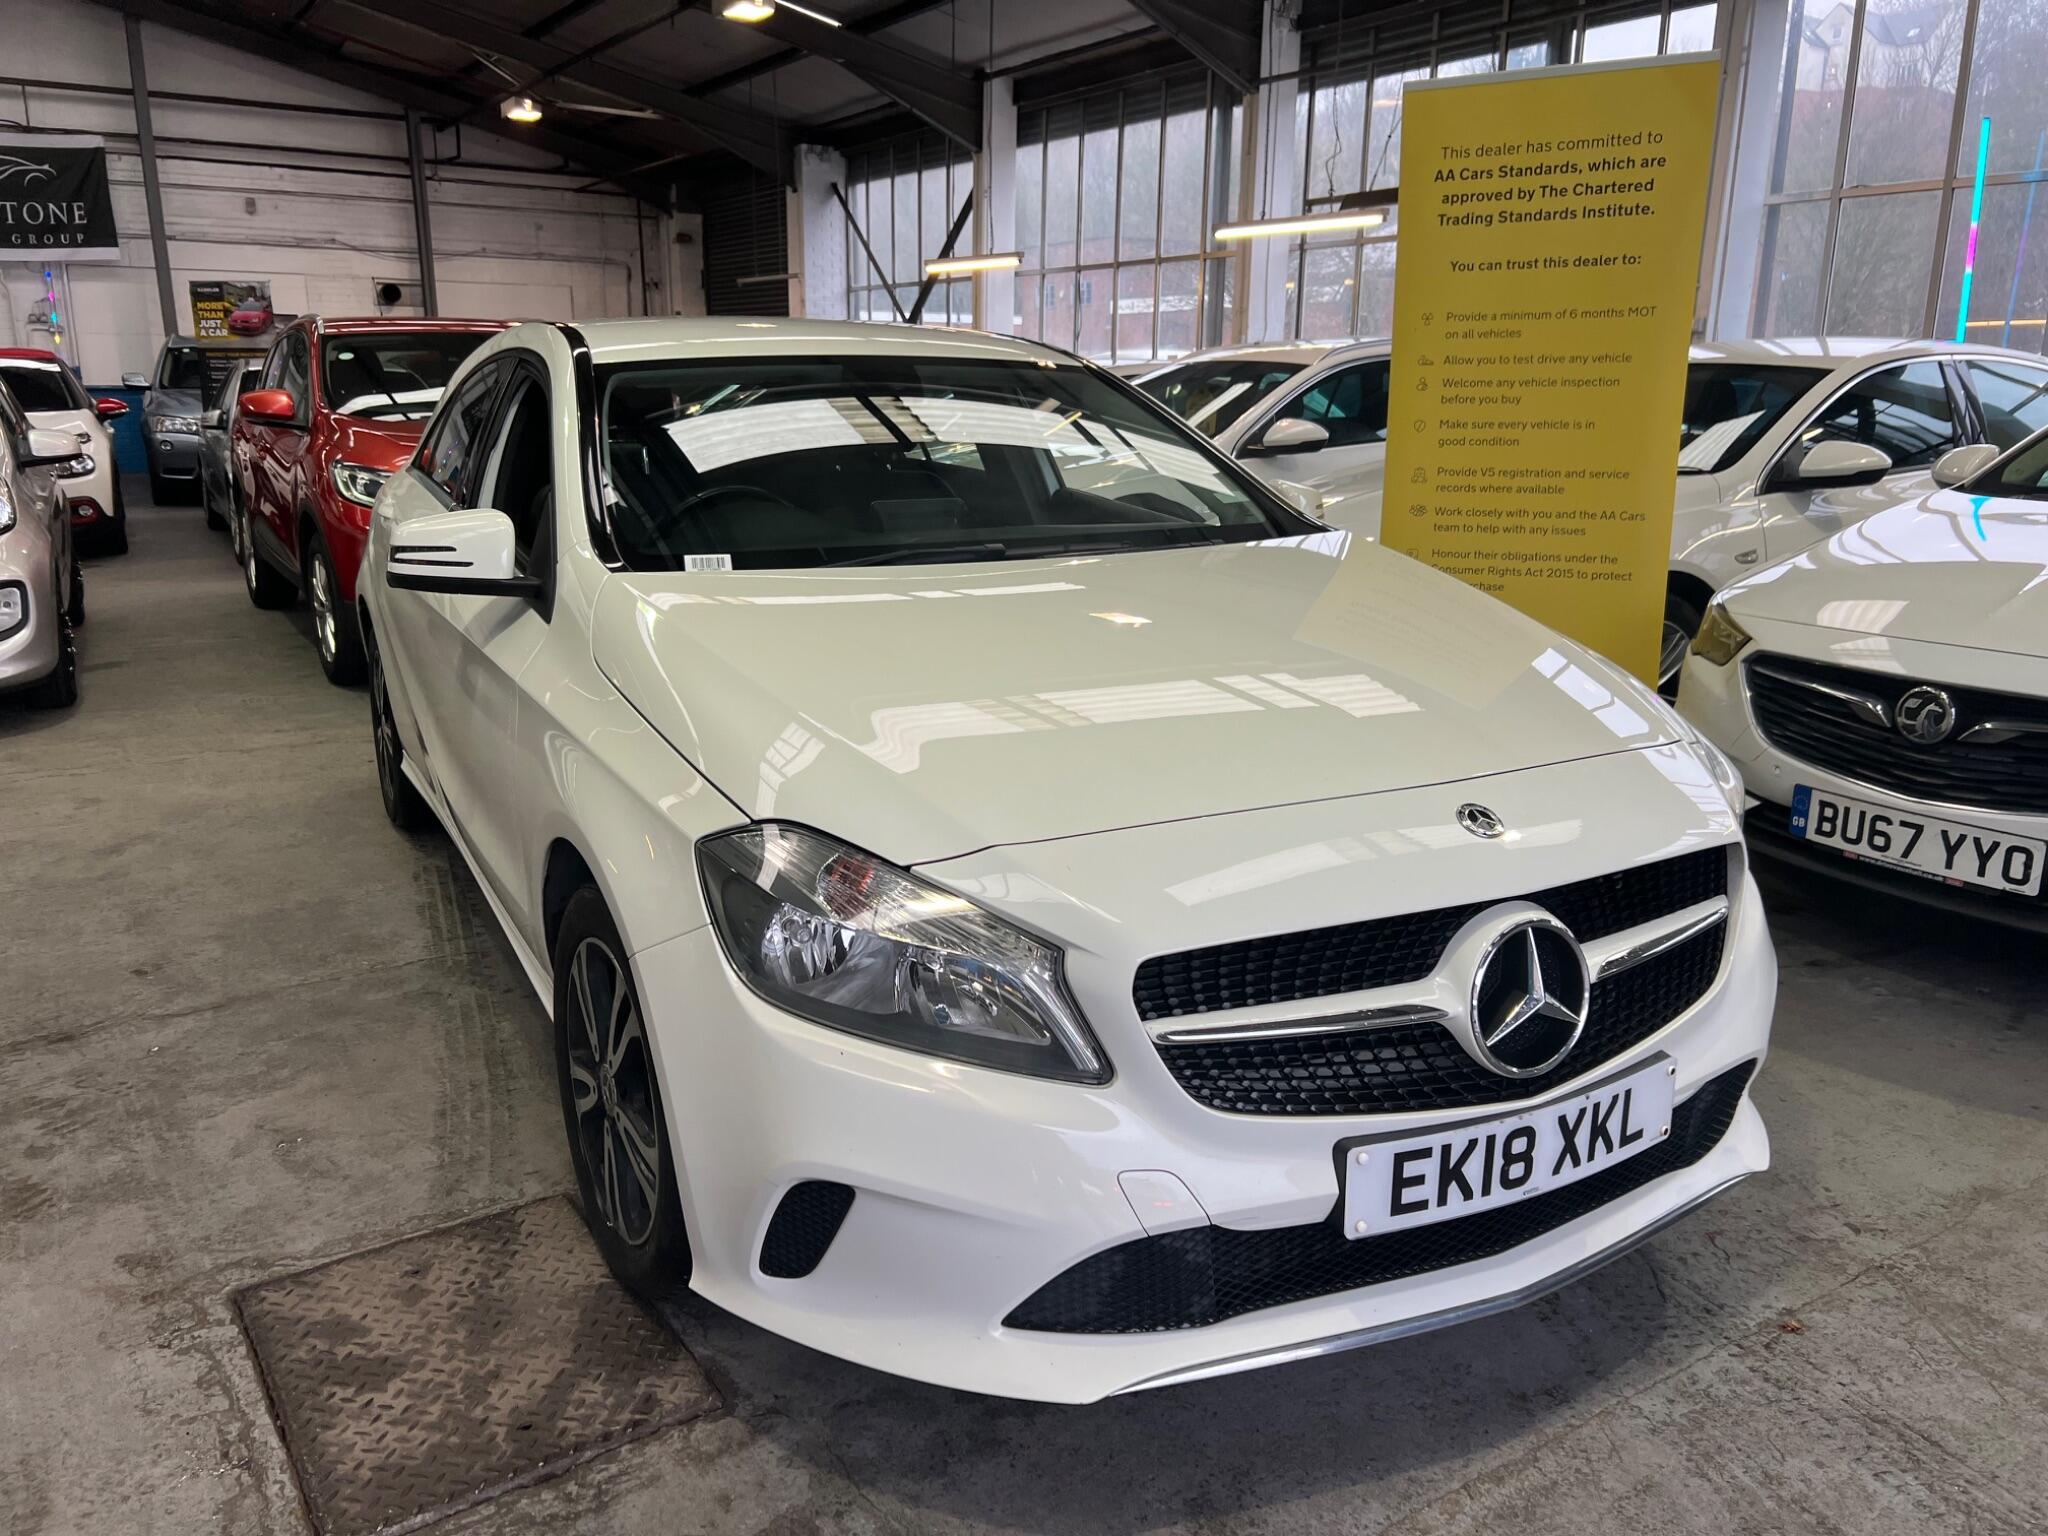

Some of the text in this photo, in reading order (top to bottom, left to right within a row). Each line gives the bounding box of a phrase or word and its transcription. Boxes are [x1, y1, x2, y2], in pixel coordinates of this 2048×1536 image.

[1440, 131, 1663, 160] This dealer has committed to
[1433, 157, 1667, 182] AA Cars Standards, which are
[1441, 178, 1655, 206] approved by The Chartered
[1437, 203, 1655, 227] Trading Standards Institute.
[11, 233, 84, 245] GROUP
[1450, 254, 1642, 272] You can trust this dealer to:
[197, 302, 224, 310] MORE
[1446, 305, 1657, 322] Provide a minimum of 6 months MOT
[198, 311, 224, 319] THAN
[200, 320, 222, 328] JUST
[209, 328, 229, 336] CAR
[1444, 327, 1522, 340] on all vehicles
[1442, 351, 1633, 368] Allow you to test drive any vehicle
[1442, 376, 1621, 390] Welcome any vehicle inspection
[1440, 393, 1522, 407] before you buy
[1439, 418, 1596, 433] Make sure every vehicle is in
[1437, 436, 1520, 449] good condition
[1436, 466, 1631, 480] Provide V5 registration and service
[1435, 483, 1565, 495] records where available
[1434, 506, 1646, 522] Work closely with you and the AA Cars
[1433, 522, 1587, 537] team to help with any issues
[1431, 548, 1619, 565] Honour their obligations under the
[1487, 565, 1523, 578] Rights
[1523, 567, 1544, 578] Act
[1546, 567, 1575, 579] 2015
[1576, 569, 1589, 580] to
[1590, 571, 1633, 582] protect
[1792, 816, 1805, 828] GB
[1814, 800, 2034, 886] BU67 YYO
[1390, 1088, 1644, 1217] EK18 XKL
